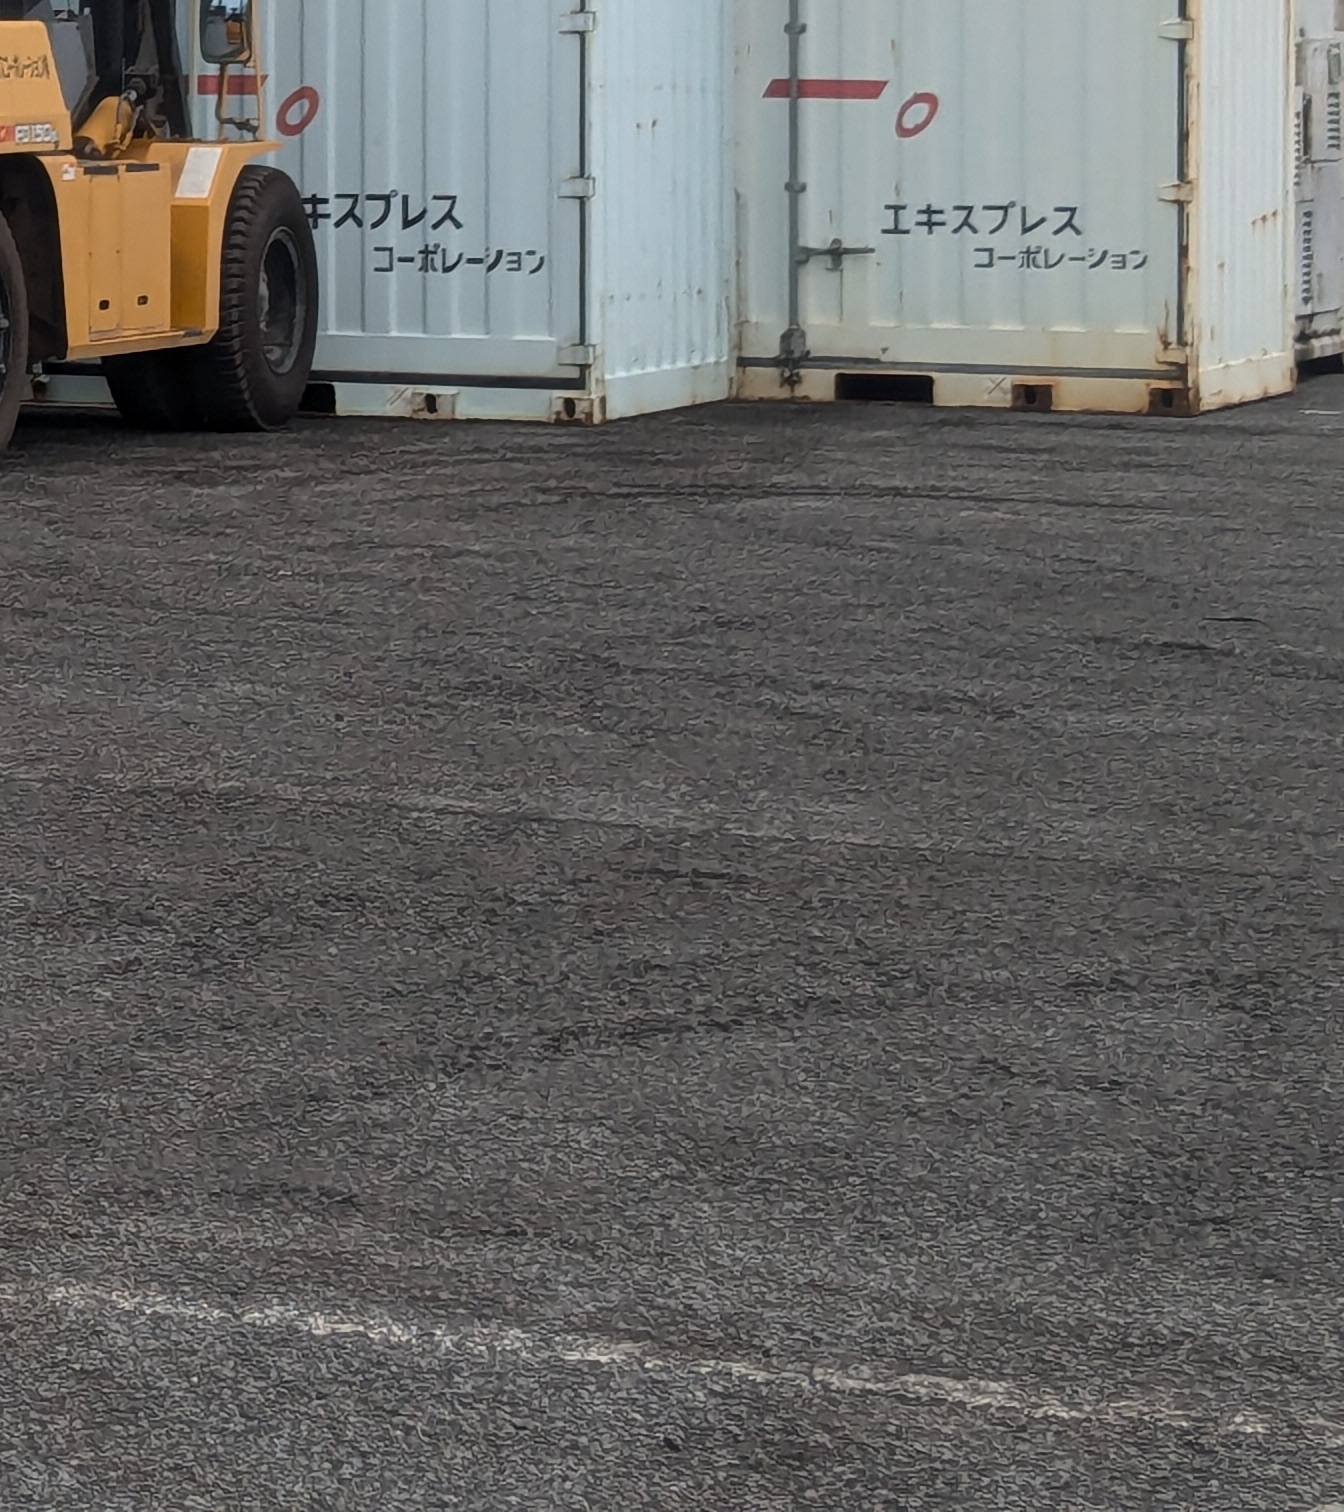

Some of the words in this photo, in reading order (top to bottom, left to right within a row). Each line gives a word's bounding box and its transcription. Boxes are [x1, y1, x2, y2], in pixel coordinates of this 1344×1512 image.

[302, 189, 464, 230] キスプレス
[881, 201, 1083, 236] エキスプレス
[373, 243, 546, 275] コーポレーション
[973, 245, 1149, 270] コーポレーション
